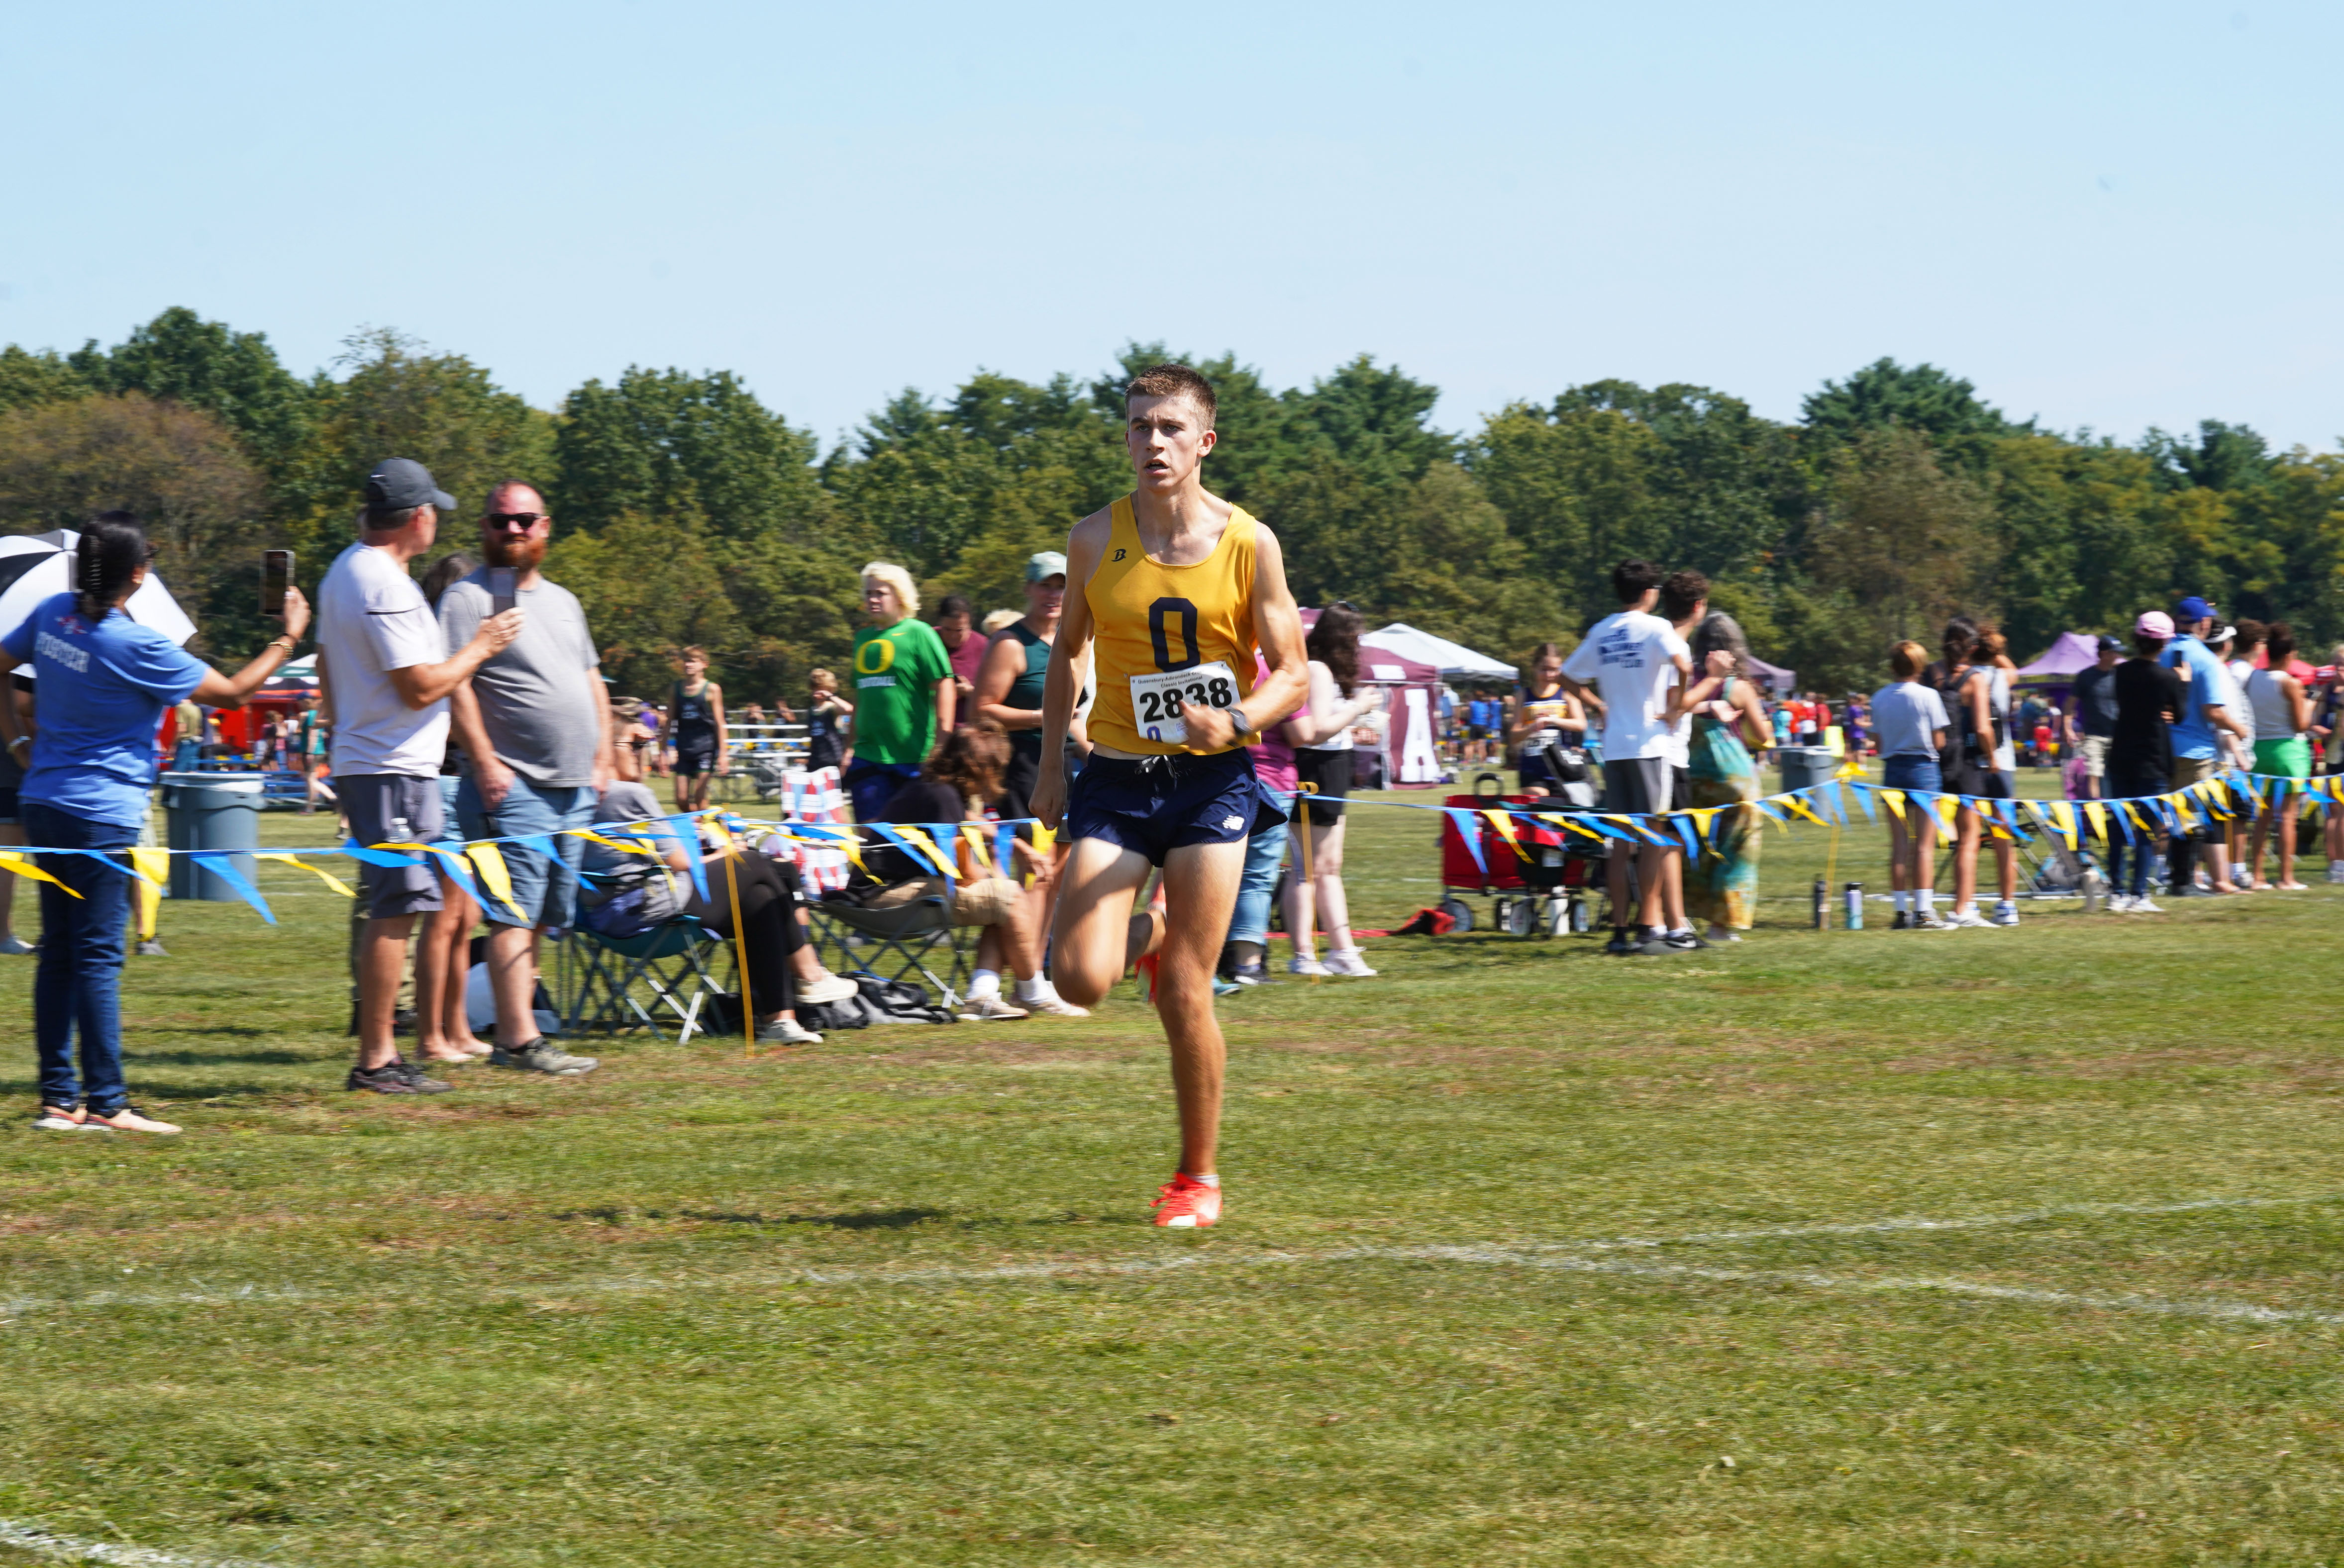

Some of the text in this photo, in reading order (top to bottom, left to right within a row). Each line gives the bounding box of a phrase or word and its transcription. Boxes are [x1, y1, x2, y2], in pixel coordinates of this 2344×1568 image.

[855, 639, 895, 674] O
[1139, 677, 1233, 723] 2838
[1178, 676, 1203, 686] Invitational
[1400, 688, 1441, 782] A
